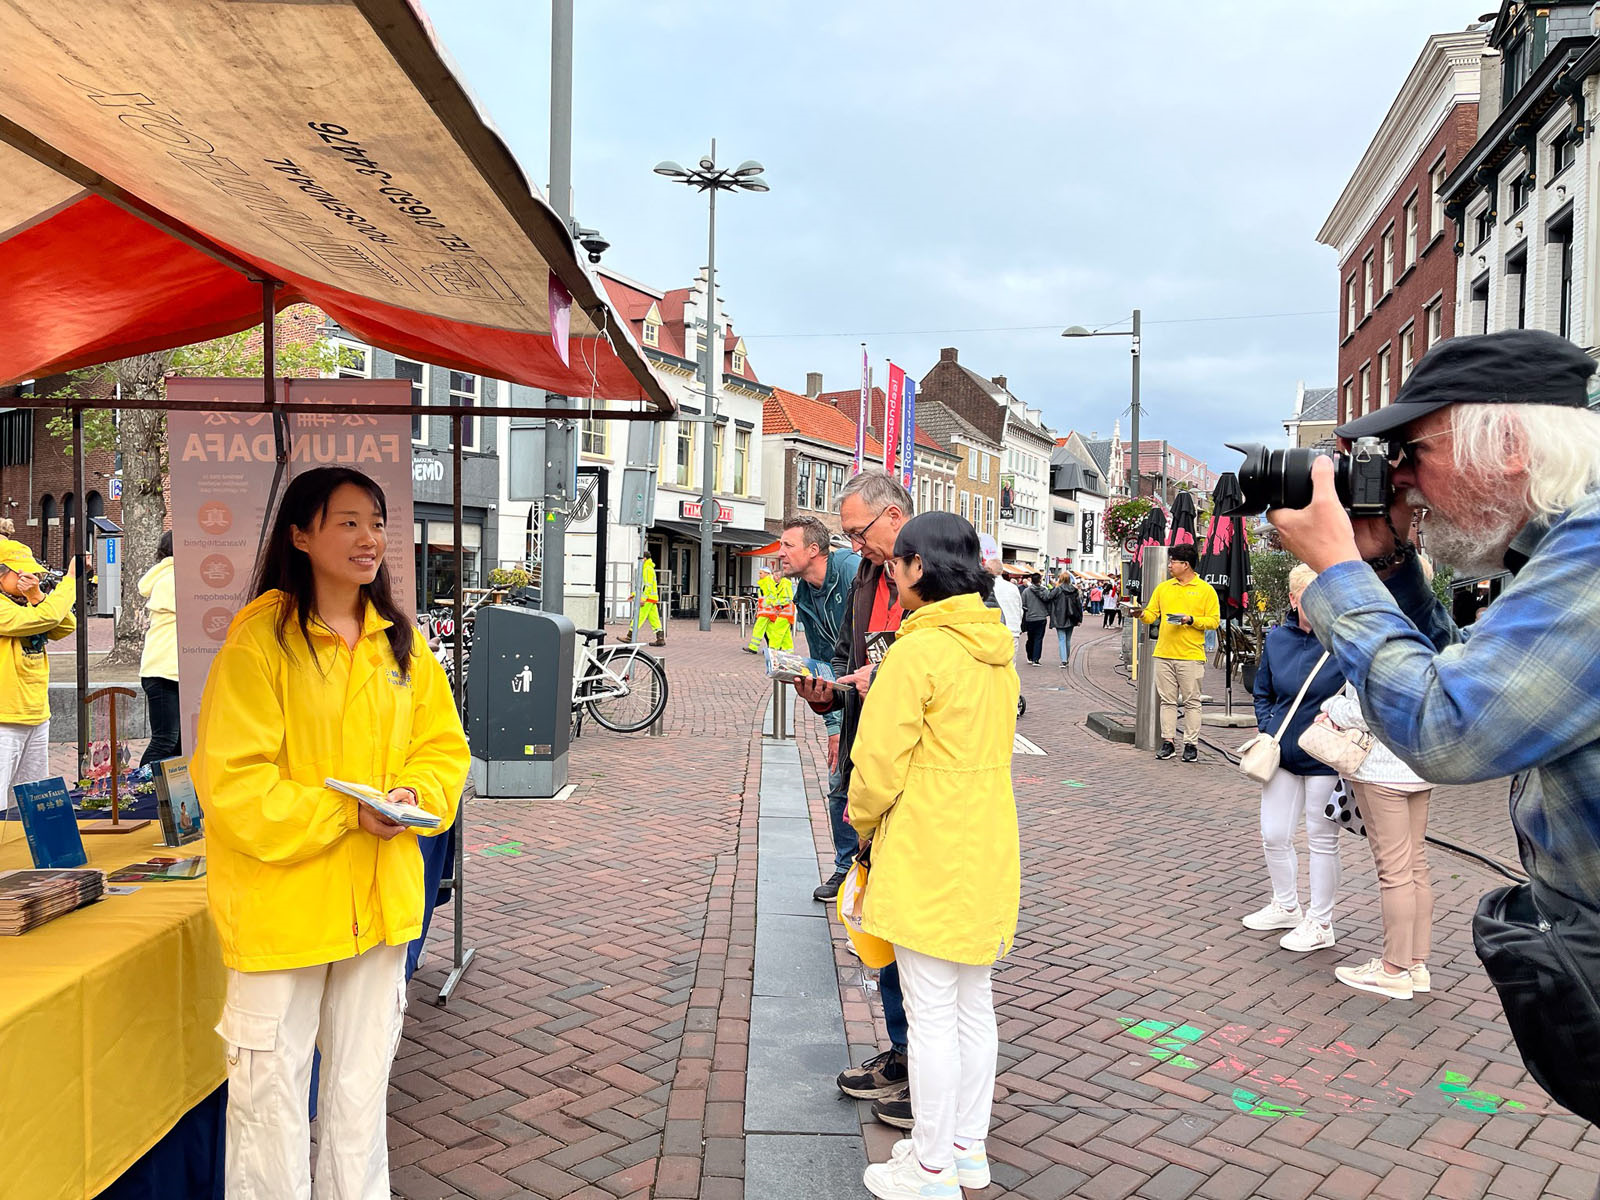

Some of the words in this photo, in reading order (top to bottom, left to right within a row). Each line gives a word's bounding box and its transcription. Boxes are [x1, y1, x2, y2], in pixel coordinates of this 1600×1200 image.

[263, 157, 402, 246] ROOSENDAAL
[307, 121, 446, 230] 01650-34476
[1085, 513, 1093, 553] BOGERS
